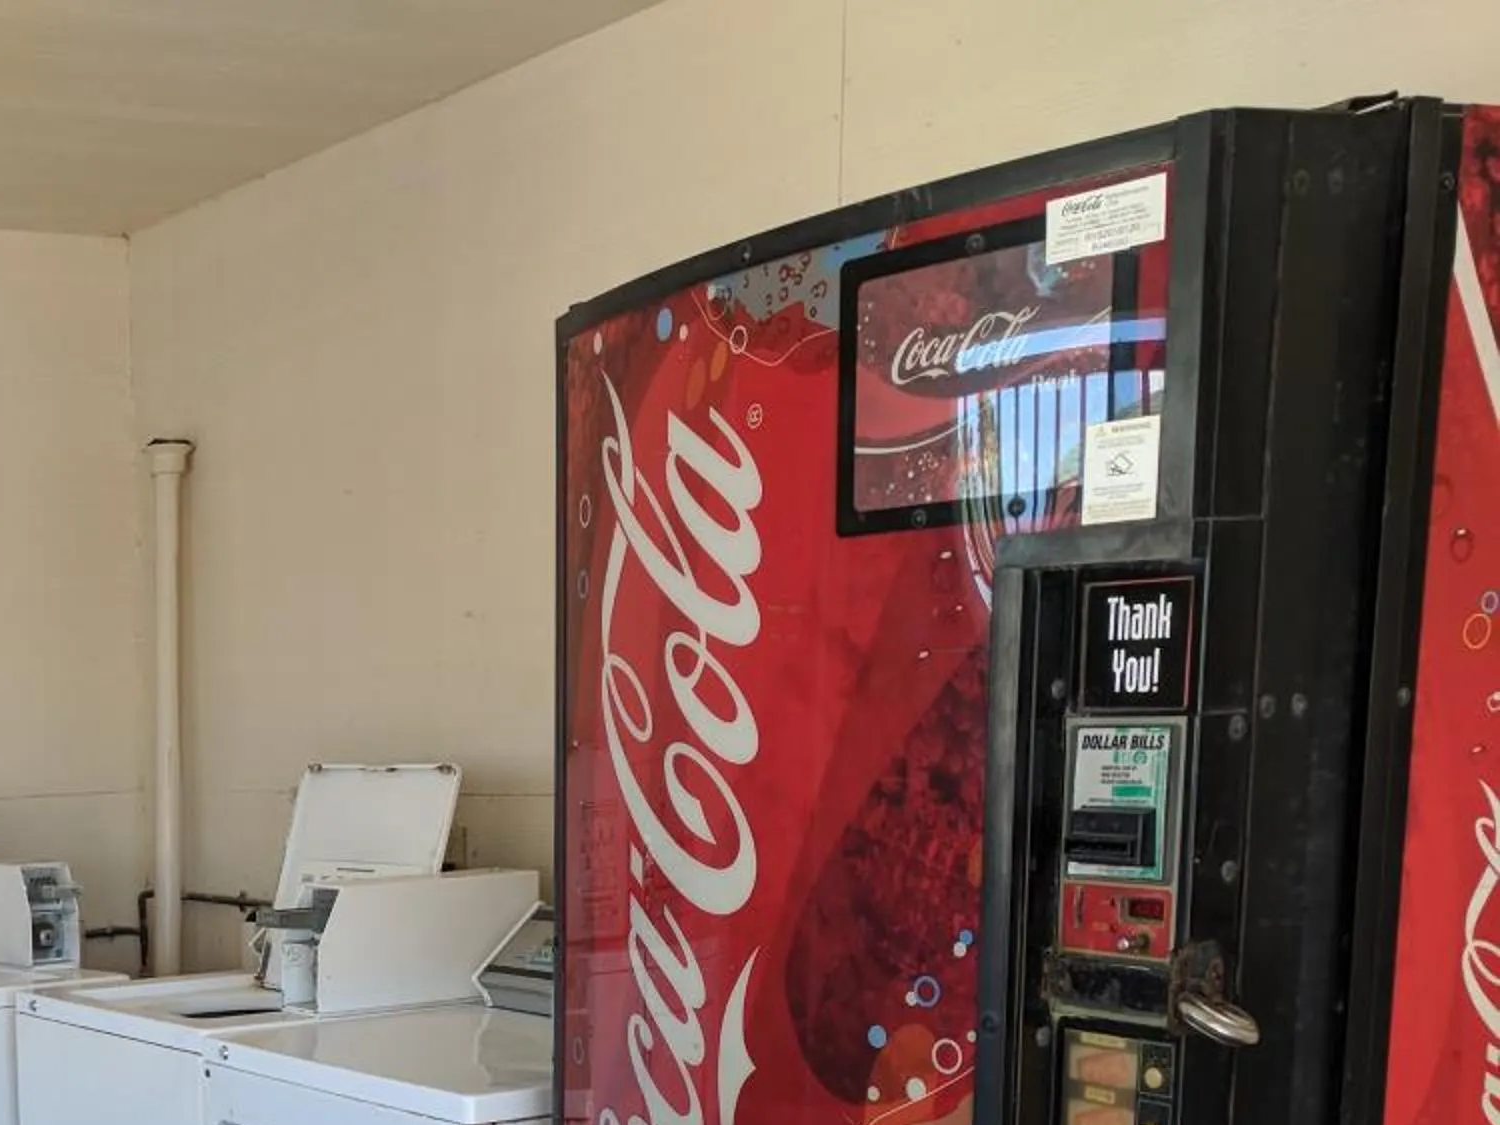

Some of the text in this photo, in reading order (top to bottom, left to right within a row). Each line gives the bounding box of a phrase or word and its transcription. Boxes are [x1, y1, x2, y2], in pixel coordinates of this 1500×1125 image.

[891, 305, 1040, 385] Coca-Cola
[1107, 593, 1173, 641] Thank
[1112, 647, 1161, 693] You!
[1081, 733, 1165, 750] DOLLAR BILLS
